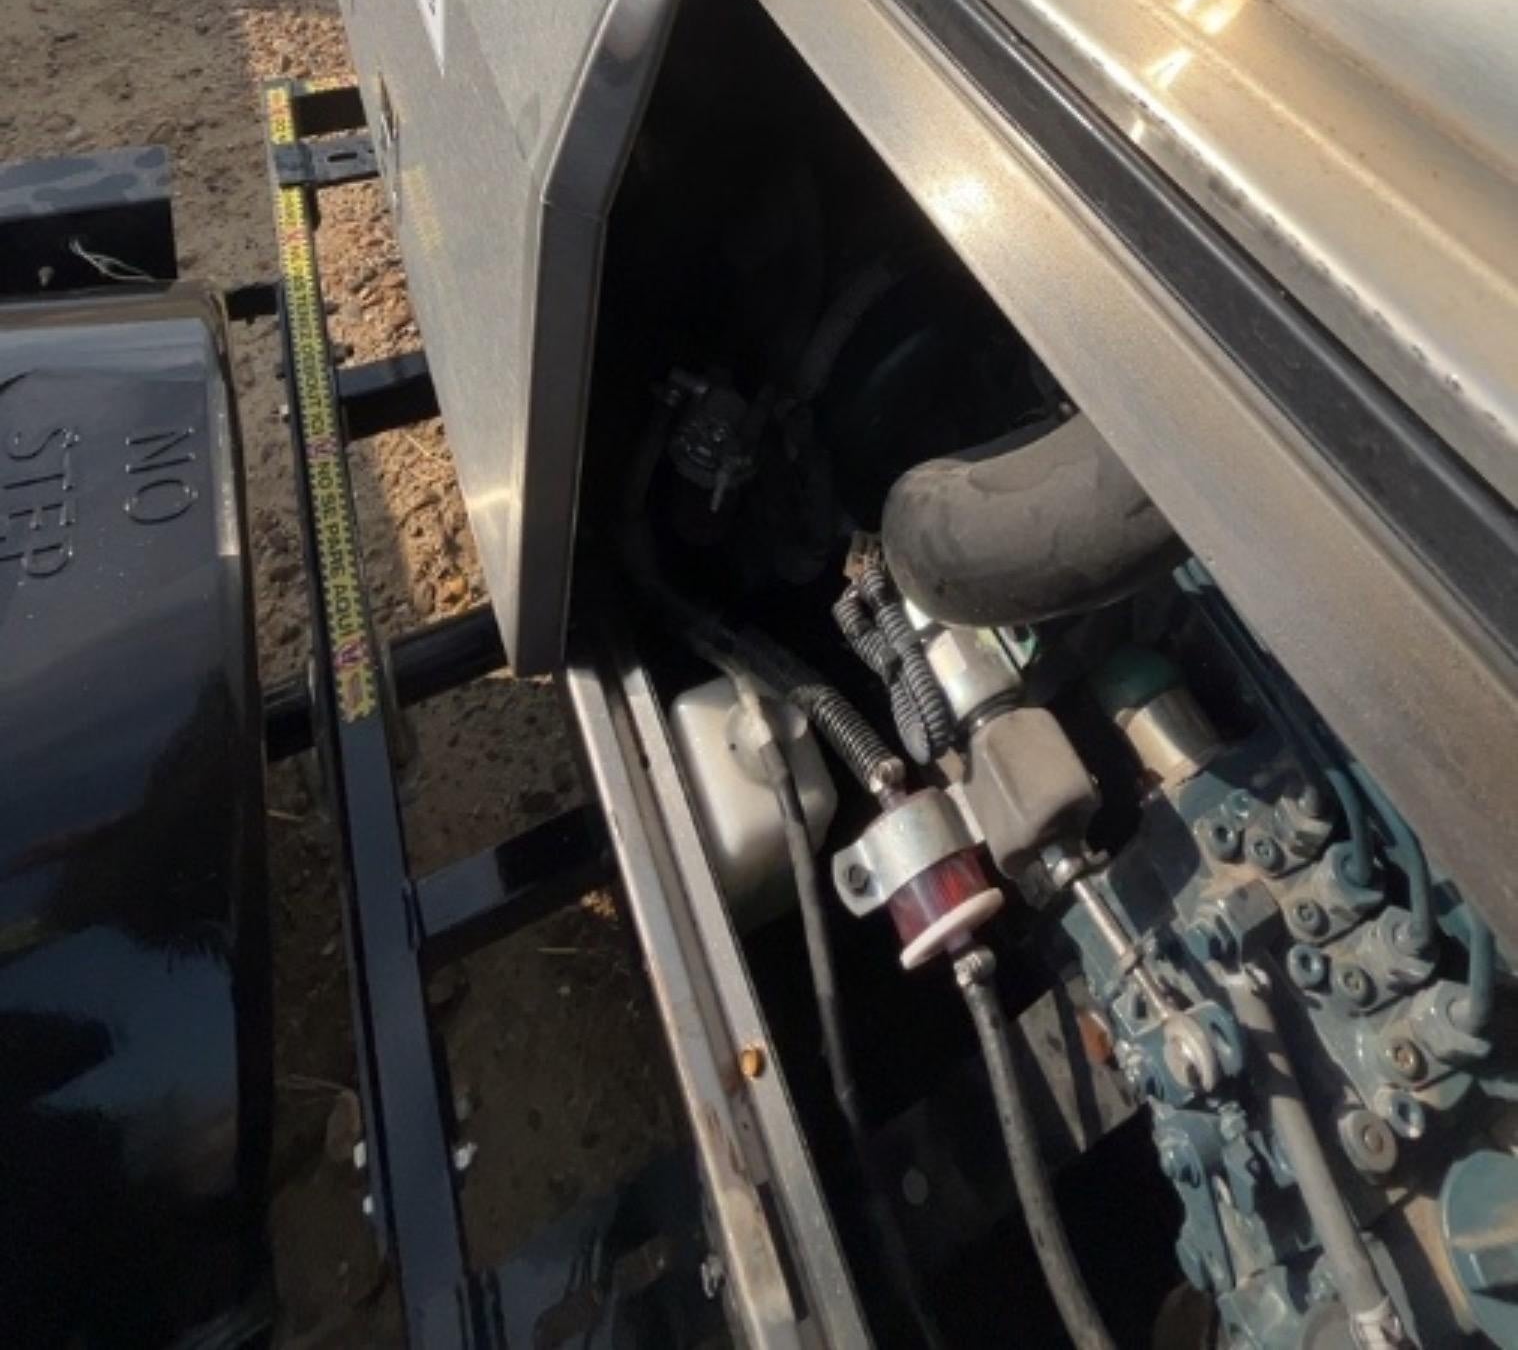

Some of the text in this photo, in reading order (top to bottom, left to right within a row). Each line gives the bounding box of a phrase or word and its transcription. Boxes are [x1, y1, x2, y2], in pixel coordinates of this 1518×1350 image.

[0, 427, 79, 580] STEP
[123, 426, 199, 526] NO
[316, 459, 333, 489] NO
[325, 523, 347, 578] PARE
